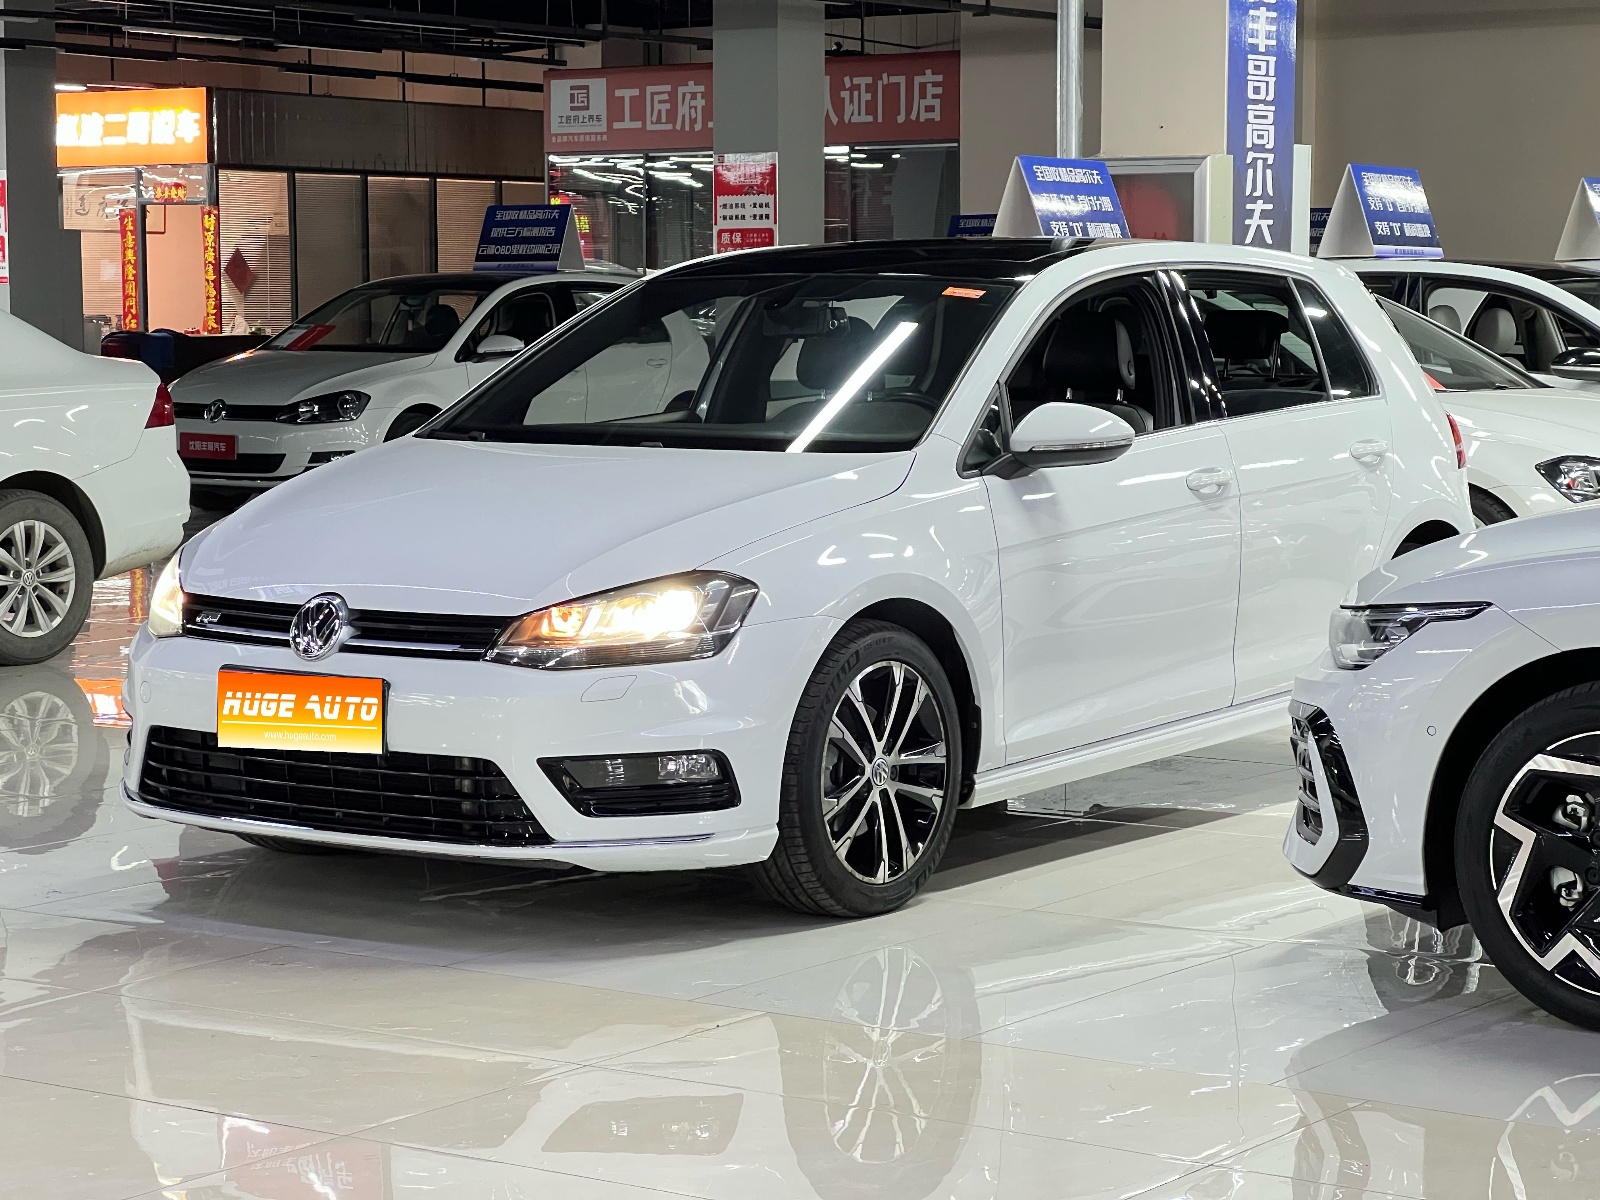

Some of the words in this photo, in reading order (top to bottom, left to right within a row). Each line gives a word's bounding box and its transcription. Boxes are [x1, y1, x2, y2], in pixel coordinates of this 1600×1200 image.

[558, 114, 603, 125] 工匠府上养车
[612, 80, 713, 132] 工匠府
[1244, 0, 1278, 244] 丰哥高尔夫
[720, 232, 742, 244] 质保
